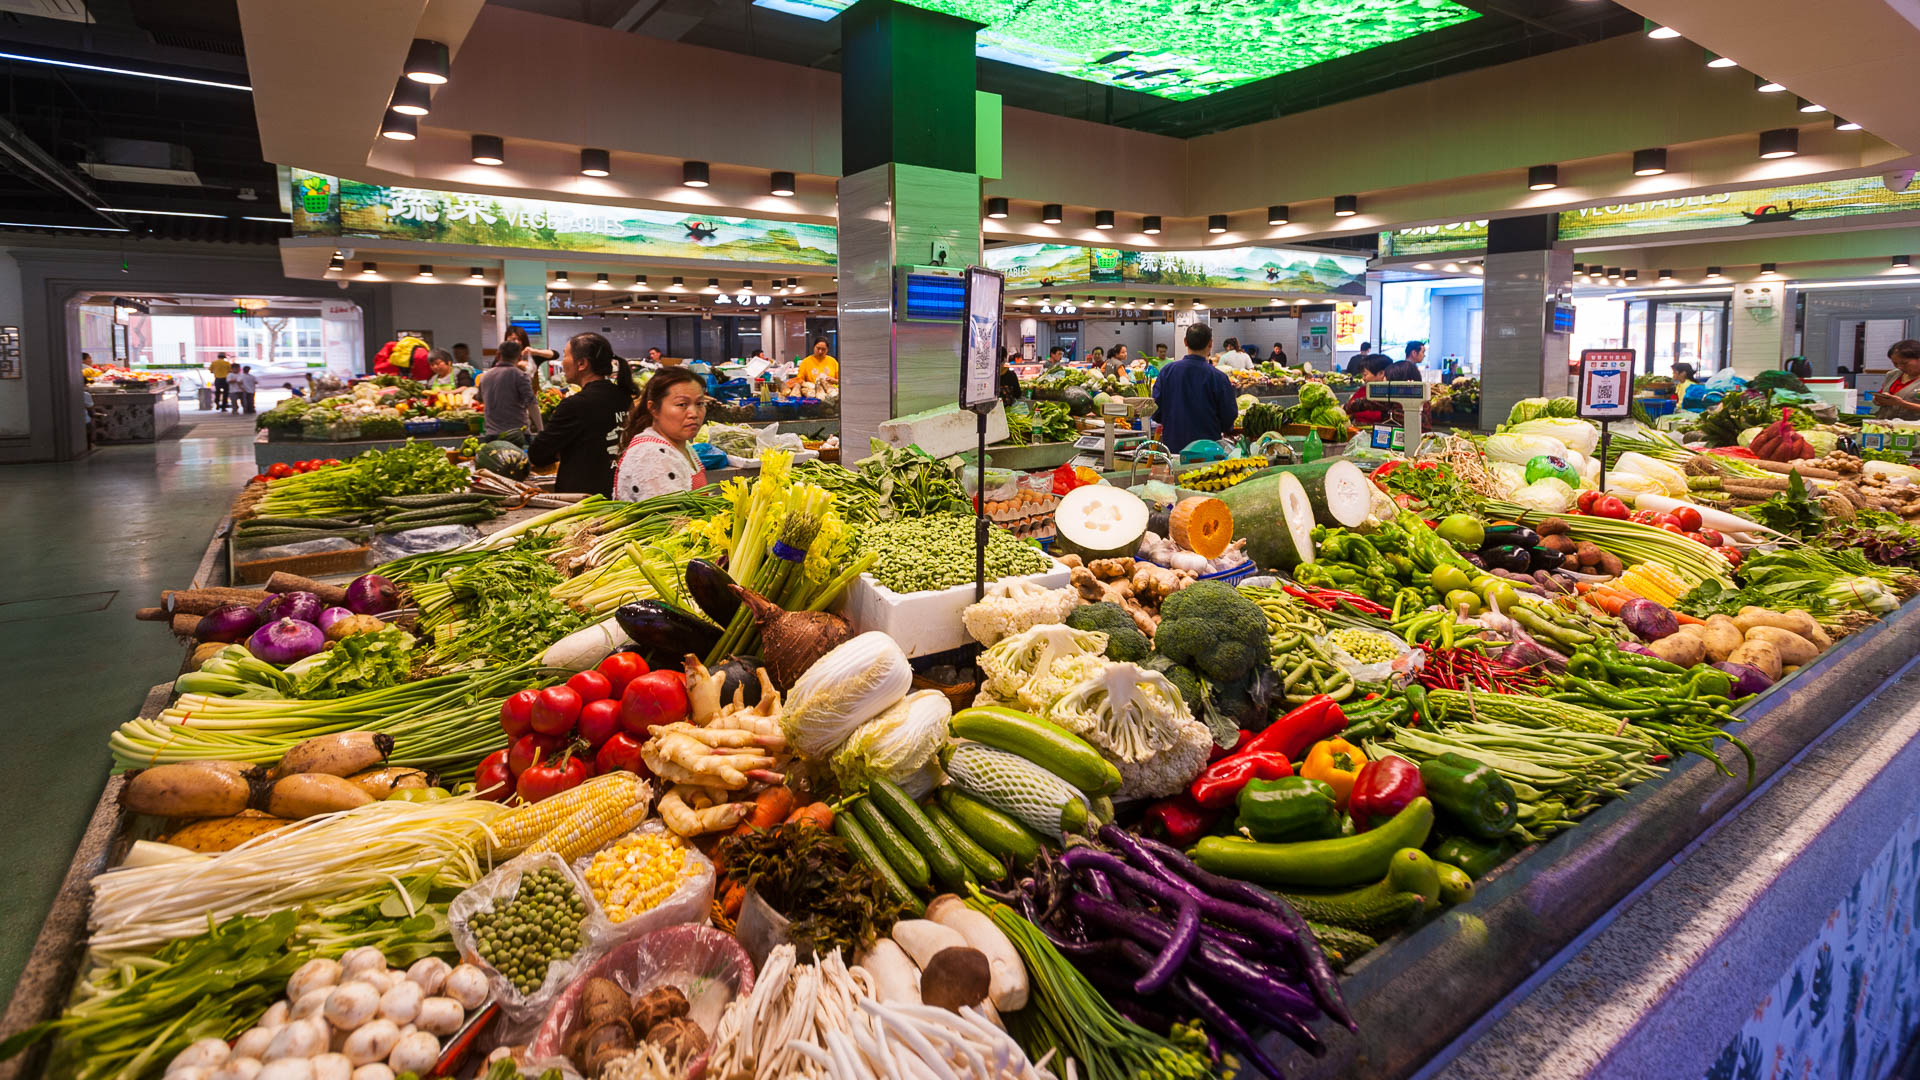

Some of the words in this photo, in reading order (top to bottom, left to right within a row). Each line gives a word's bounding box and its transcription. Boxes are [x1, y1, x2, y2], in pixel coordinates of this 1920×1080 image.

[386, 188, 498, 225] 蔬菜
[504, 208, 624, 235] VEGETABLES
[1004, 264, 1031, 277] TABLES
[1139, 252, 1180, 273] 蔬菜
